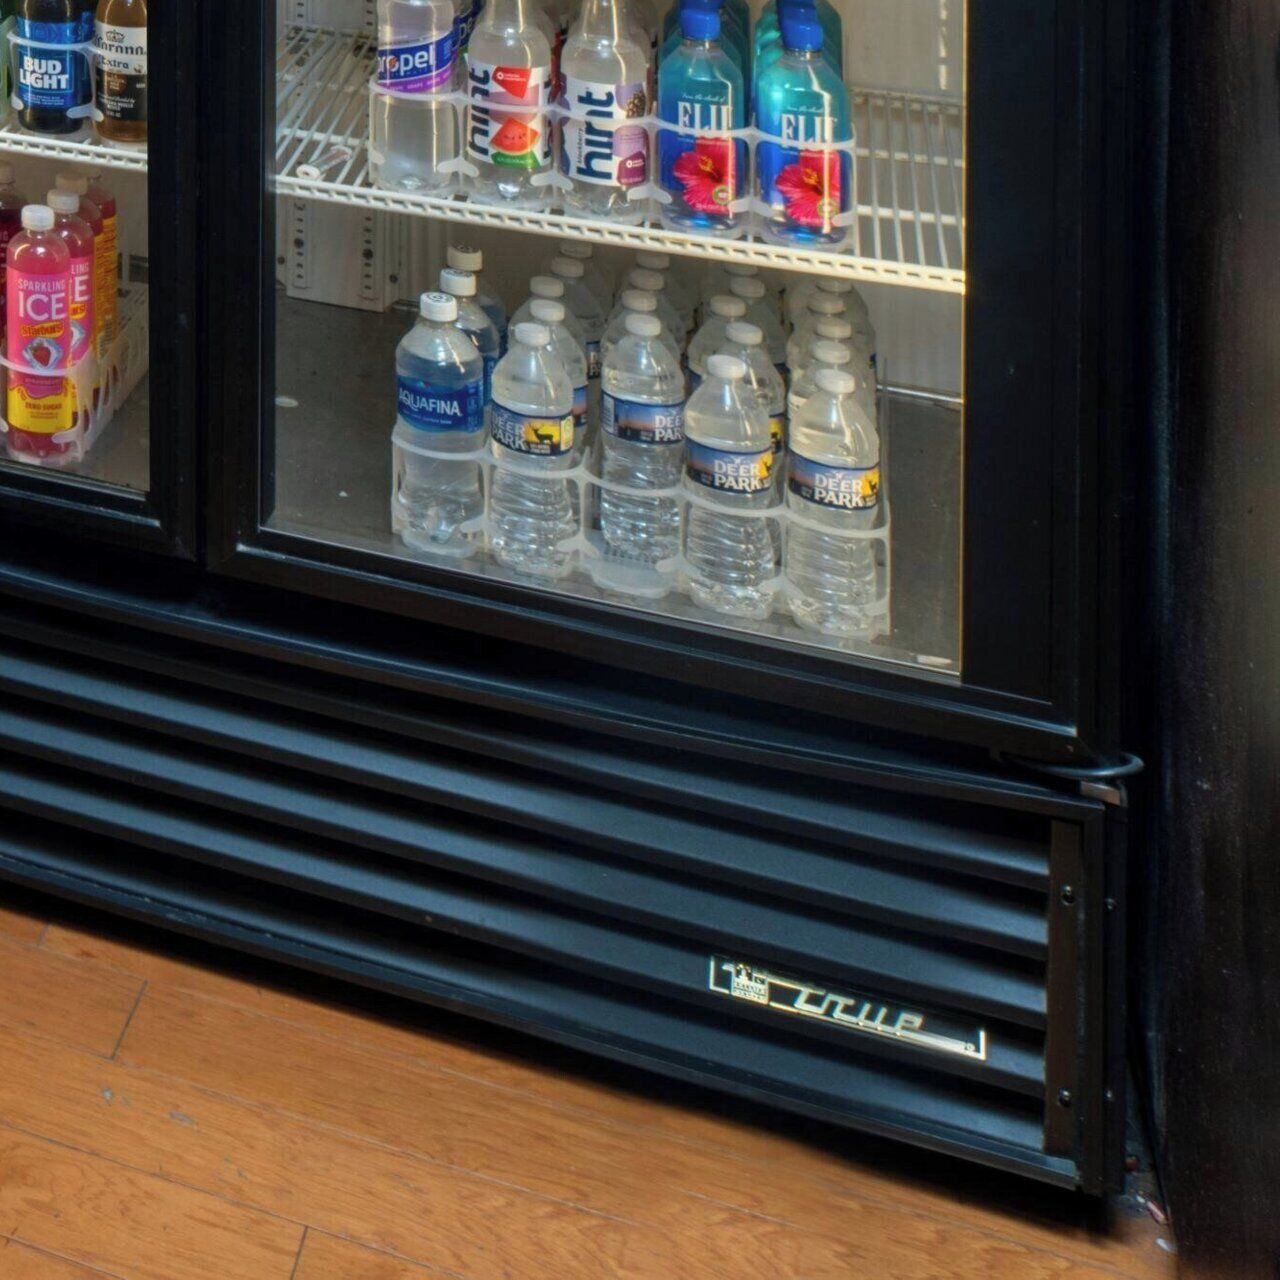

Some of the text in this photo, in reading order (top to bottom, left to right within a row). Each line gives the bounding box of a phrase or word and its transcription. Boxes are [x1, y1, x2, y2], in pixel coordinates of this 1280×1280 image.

[22, 55, 63, 74] BUD
[378, 45, 435, 76] ropel
[19, 69, 70, 91] LIGHT
[576, 90, 615, 181] hint
[18, 278, 67, 294] SPARKLING
[18, 291, 67, 321] ICE
[398, 388, 463, 418] AQUAFINA
[714, 458, 760, 477] DEER
[714, 474, 761, 493] PARK
[814, 472, 863, 492] DEER
[814, 488, 865, 509] PARK
